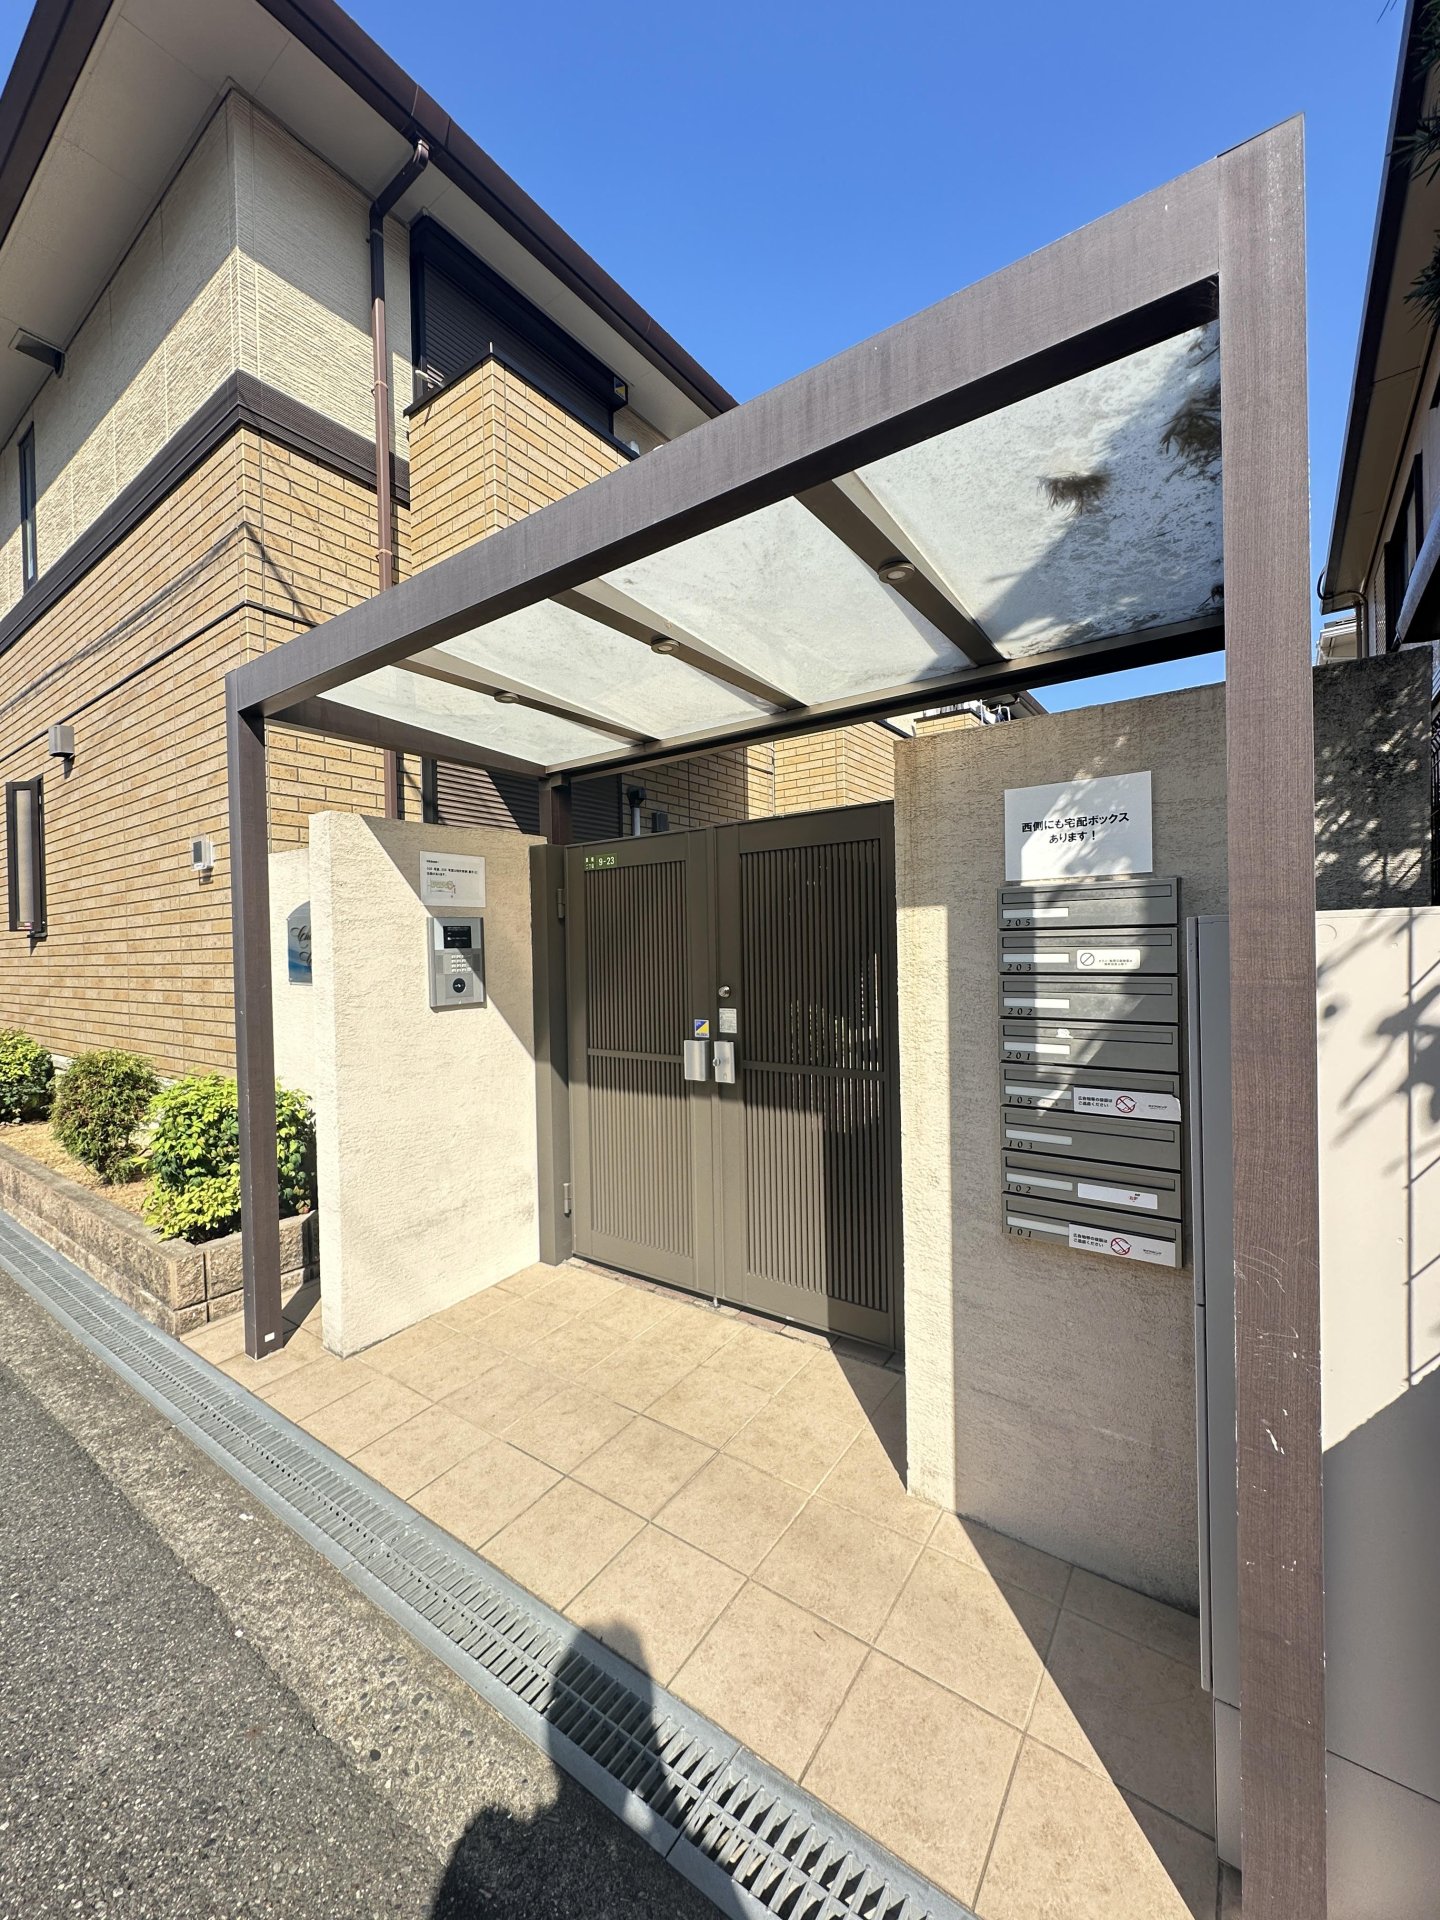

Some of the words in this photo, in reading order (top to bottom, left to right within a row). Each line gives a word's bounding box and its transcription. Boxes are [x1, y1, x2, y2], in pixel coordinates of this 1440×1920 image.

[1021, 812, 1130, 833] 西側にも宅配ボックス
[598, 856, 615, 866] 9-23
[1005, 918, 1031, 927] 205
[1007, 963, 1032, 971] 203
[1007, 1007, 1033, 1016] 202
[1006, 1051, 1031, 1061] 201
[1008, 1096, 1033, 1105] 105
[1008, 1140, 1033, 1150] 103
[1007, 1183, 1032, 1194] 102
[1008, 1226, 1032, 1238] 101
